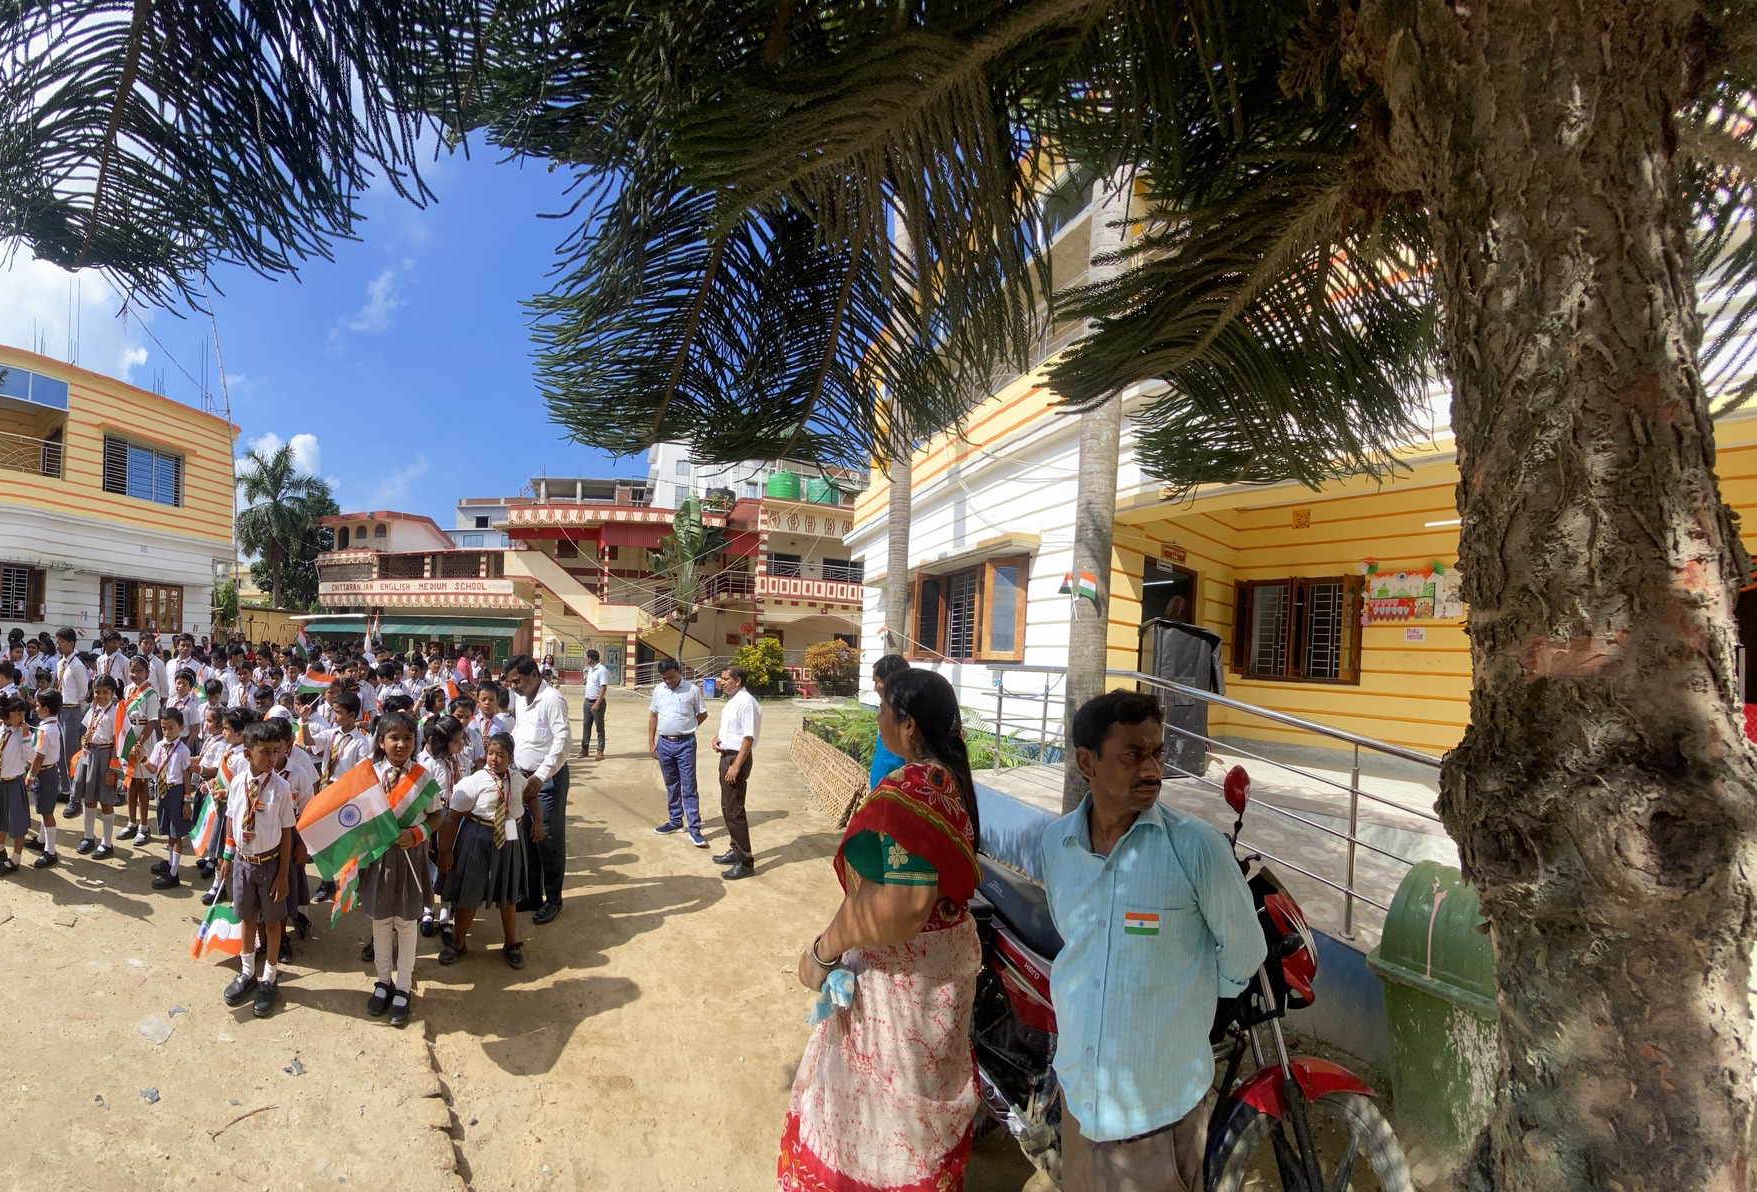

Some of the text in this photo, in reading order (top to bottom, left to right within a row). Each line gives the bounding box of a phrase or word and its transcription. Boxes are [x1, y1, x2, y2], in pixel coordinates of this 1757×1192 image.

[331, 583, 374, 592] CHITTARANJAN
[380, 583, 410, 591] ENGLISH
[418, 583, 447, 591] MEDIUM
[454, 582, 487, 591] SCHOOL
[1023, 961, 1040, 980] Hero
